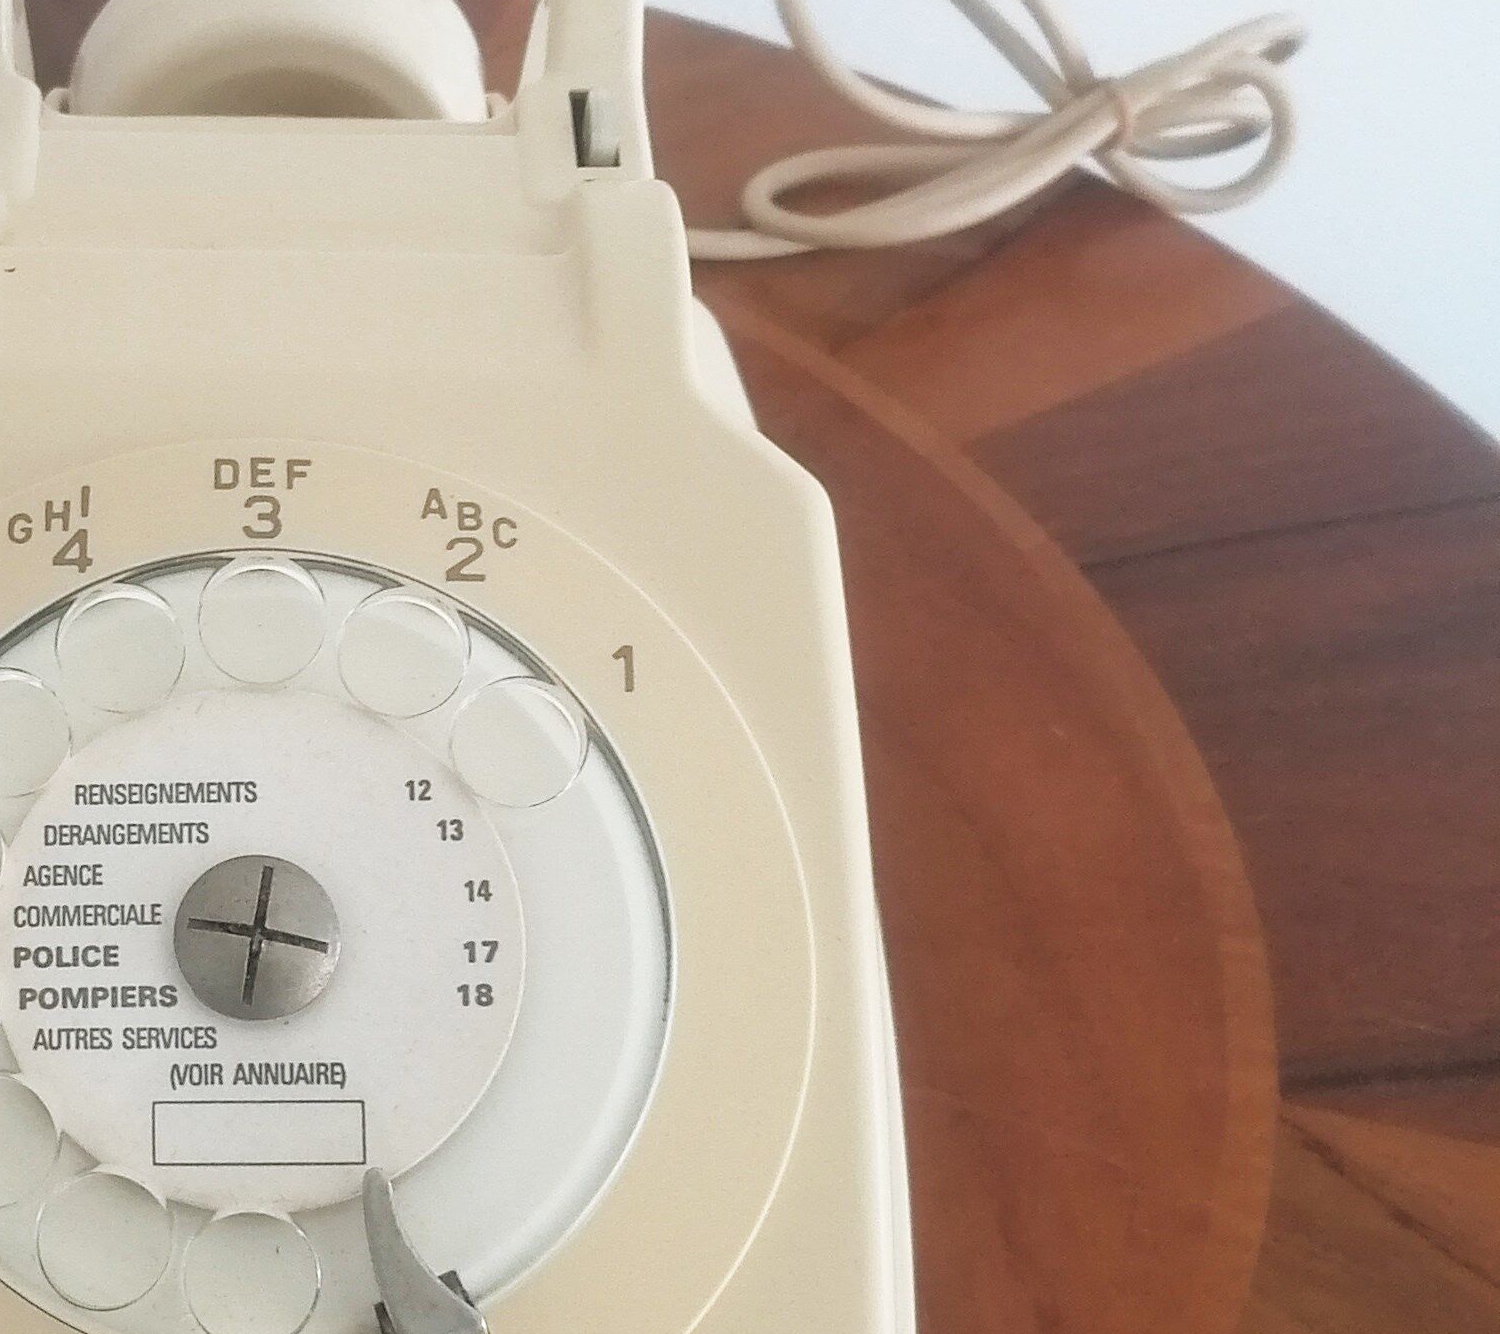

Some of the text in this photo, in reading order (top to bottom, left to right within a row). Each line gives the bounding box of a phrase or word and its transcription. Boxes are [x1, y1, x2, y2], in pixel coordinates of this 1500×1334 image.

[241, 495, 283, 540] 3
[52, 528, 93, 573] 4
[445, 536, 487, 583] 2
[611, 645, 635, 693] 1
[73, 780, 259, 807] RENSEIGNEMENTS
[404, 779, 433, 802] 12
[43, 821, 210, 847] DERANGEMENTS
[435, 818, 465, 841] 13
[22, 863, 104, 888] AGENCE
[463, 880, 494, 903] 14
[12, 903, 163, 928] COMMERCIALE
[12, 945, 120, 969] POLICE
[462, 940, 499, 964] 17
[18, 985, 179, 1011] POMPIERS
[456, 983, 495, 1007] 18
[31, 1026, 218, 1051] AUTRES SERVICES
[169, 1061, 347, 1091] (VOIR ANNUAIRE)
